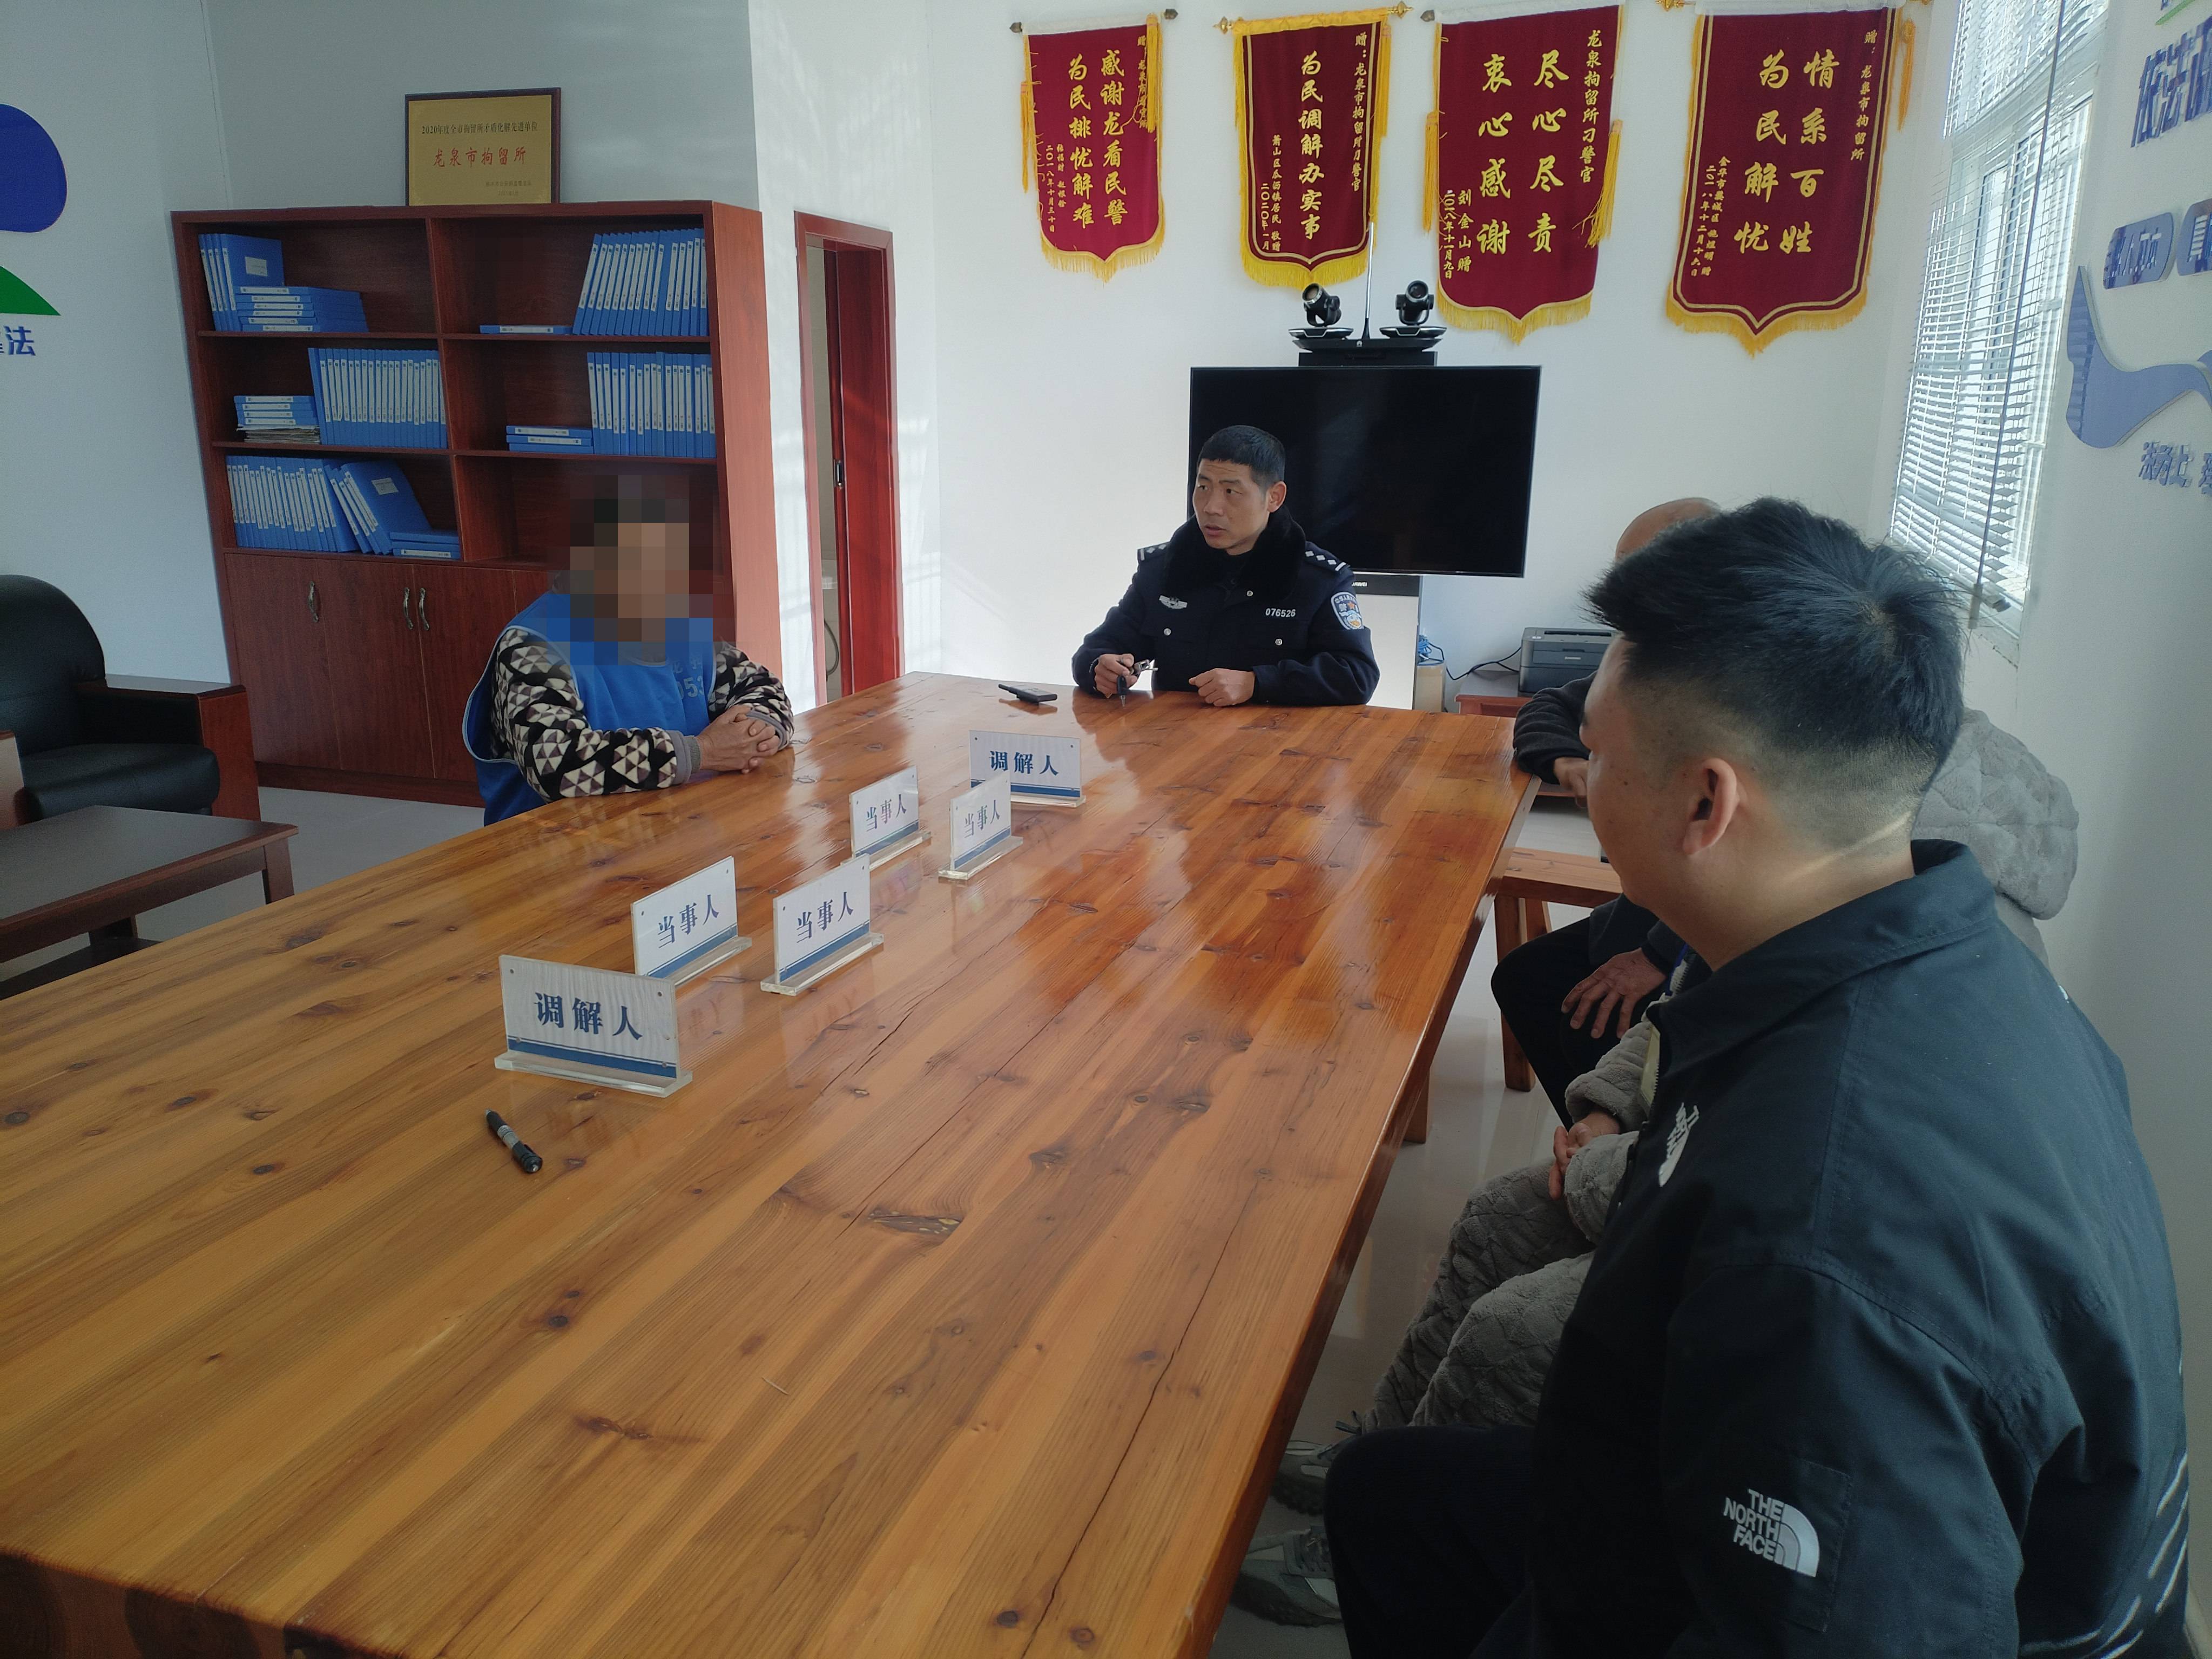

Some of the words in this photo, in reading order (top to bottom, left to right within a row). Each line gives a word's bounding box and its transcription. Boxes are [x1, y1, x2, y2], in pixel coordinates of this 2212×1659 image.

[433, 146, 526, 168] 龙泉市拘留所
[1069, 53, 1095, 228] 为民排忧解难
[1101, 50, 1128, 225] 感谢龙看民警
[1298, 51, 1325, 240] 为民调解办实事
[1476, 53, 1513, 255] 衷心感谢
[1528, 49, 1570, 253] 尽心尽责
[1734, 49, 1789, 254] 为民解忧
[1779, 49, 1839, 254] 情系百姓
[0, 326, 36, 356] 法
[1265, 608, 1296, 618] 076526
[989, 751, 1059, 777] 调解人
[866, 793, 907, 832] 当事人
[964, 799, 1001, 839] 当事人
[658, 894, 719, 948] 当事人
[797, 891, 854, 943] 当事人
[534, 992, 643, 1041] 调解人
[1723, 1497, 1781, 1542] NORTH
[1748, 1488, 1784, 1522] THE
[1733, 1525, 1777, 1561] FACE
